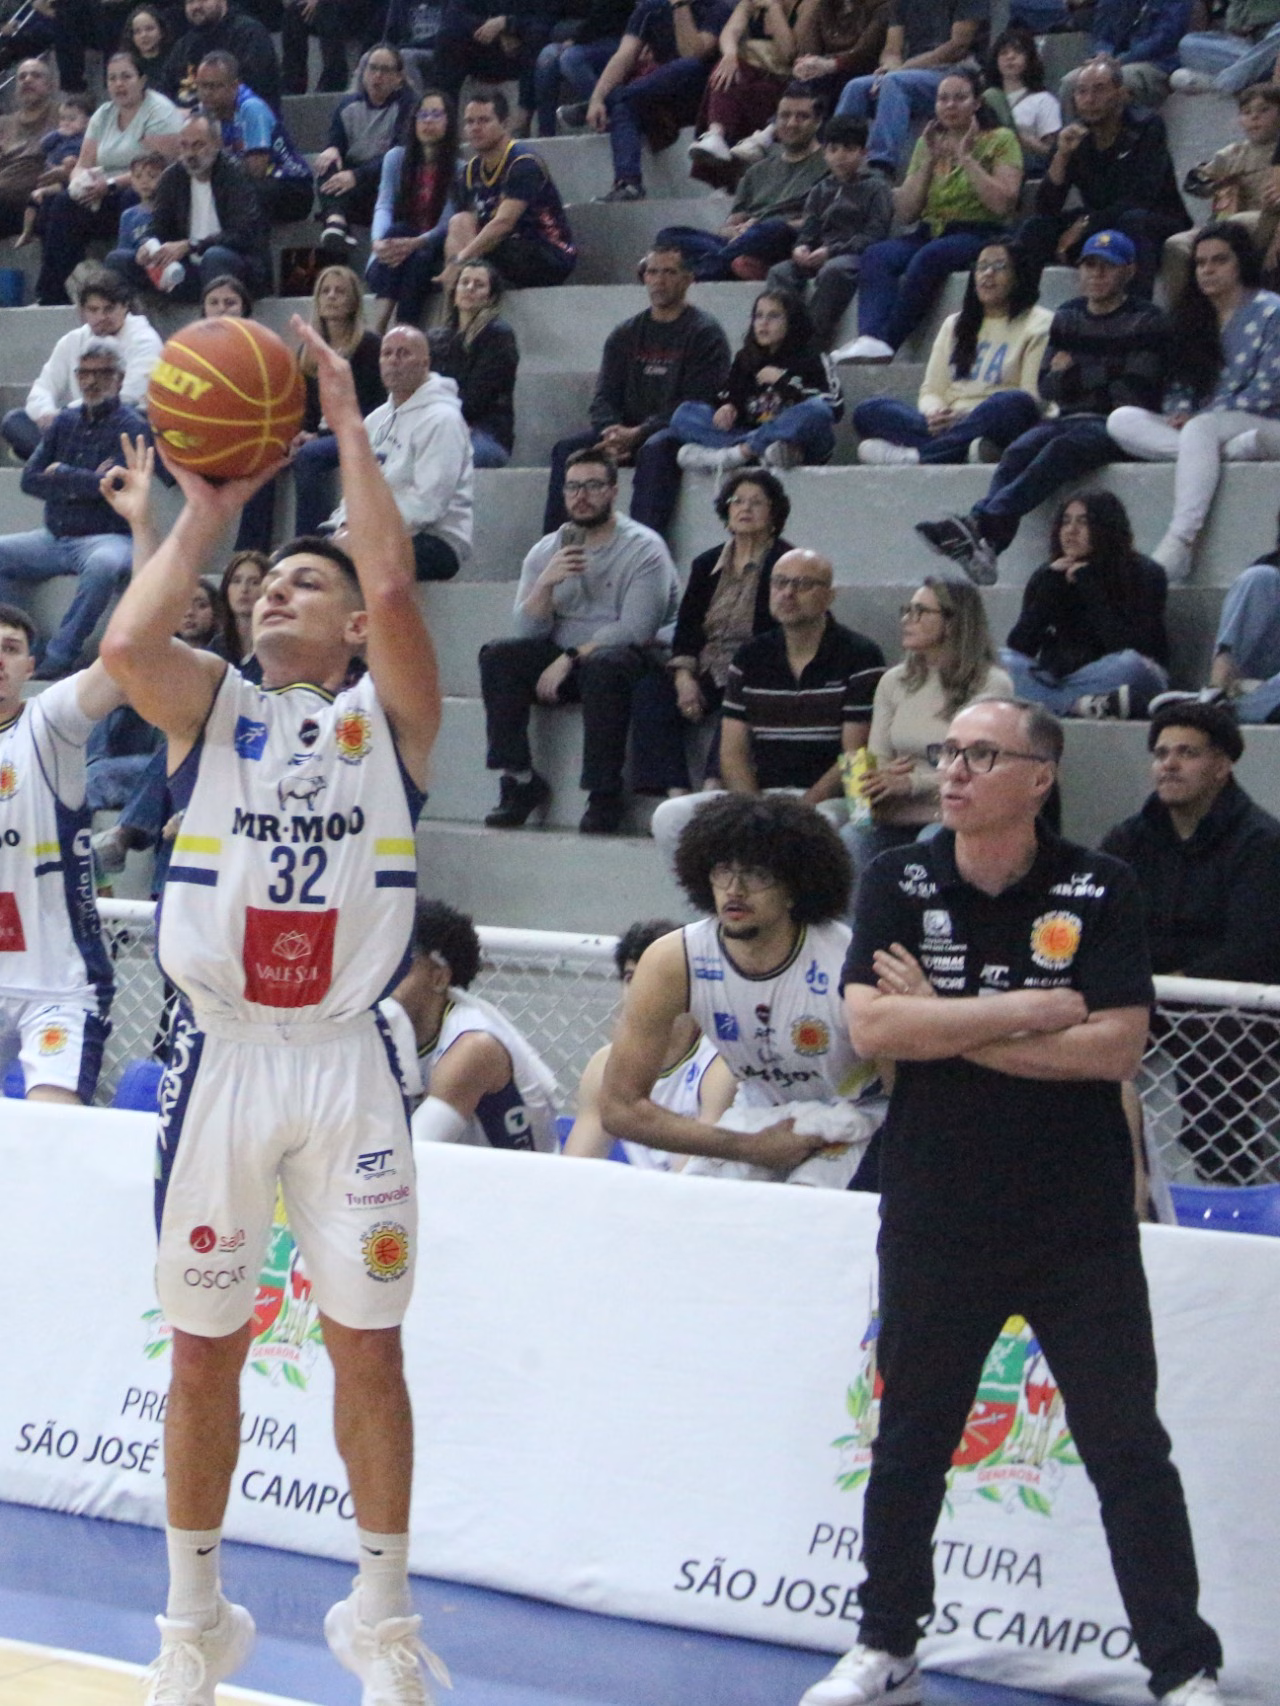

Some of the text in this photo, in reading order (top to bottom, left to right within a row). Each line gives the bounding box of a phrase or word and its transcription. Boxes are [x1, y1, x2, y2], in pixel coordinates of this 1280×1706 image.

[268, 845, 328, 905] 32
[355, 1150, 393, 1174] RT
[120, 1387, 297, 1454] PREURA
[15, 1420, 356, 1519] SÃO JOSÉ CAMPO
[809, 1523, 1042, 1588] PRTURA
[674, 1558, 757, 1601] SÃO
[973, 1608, 1140, 1662] CAMPO
